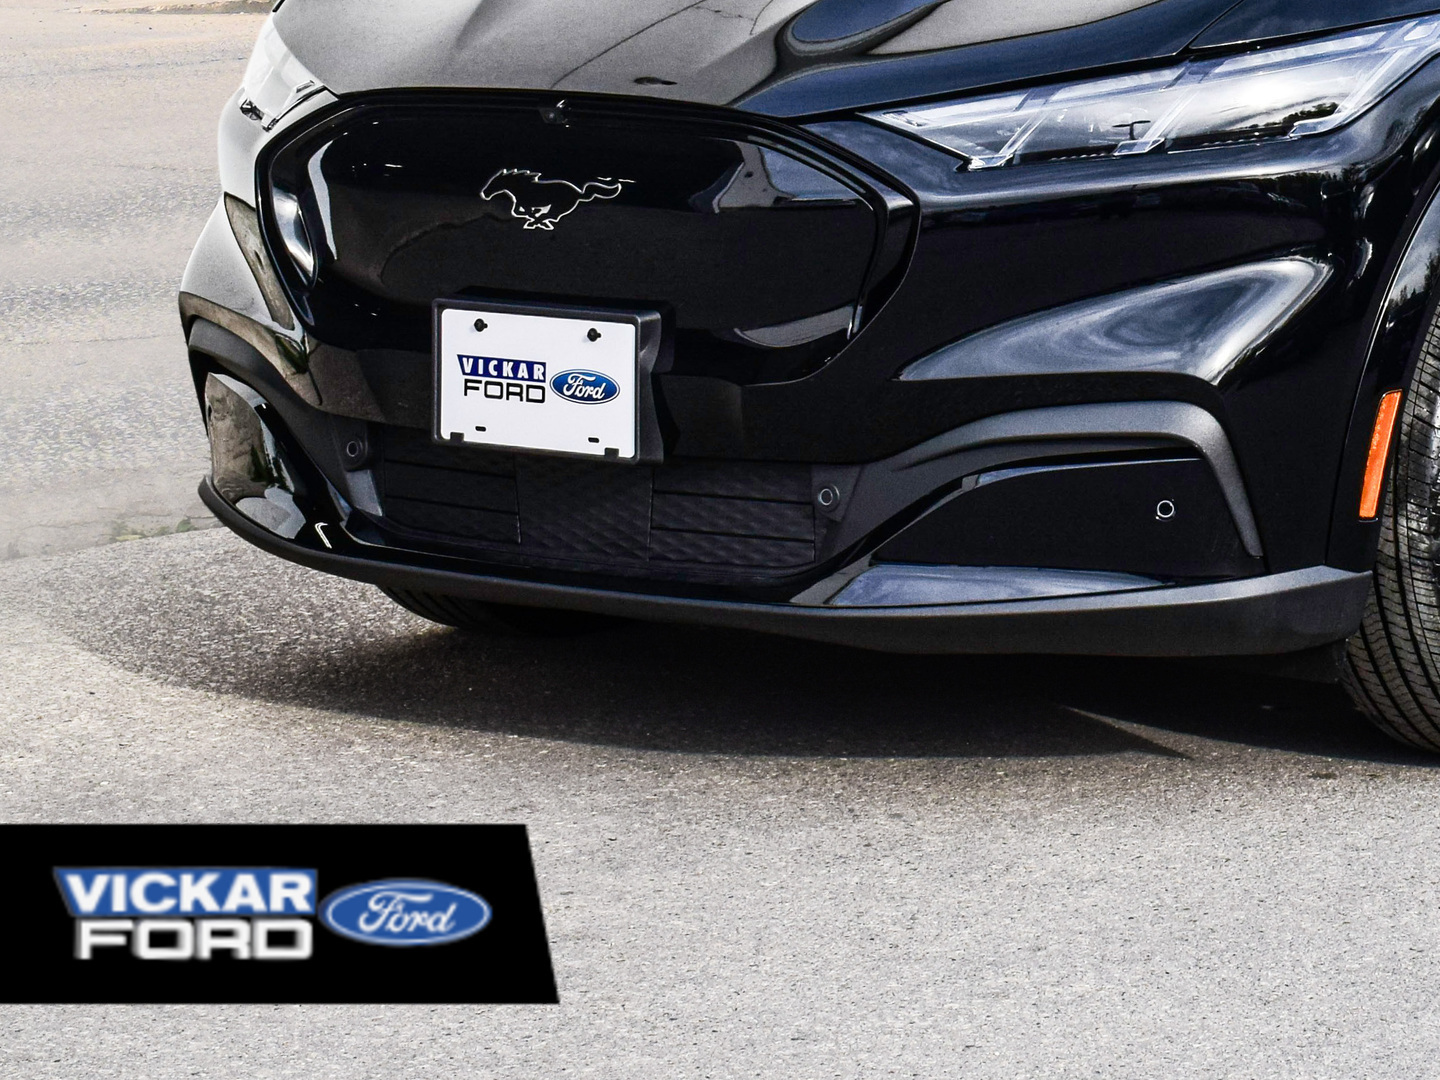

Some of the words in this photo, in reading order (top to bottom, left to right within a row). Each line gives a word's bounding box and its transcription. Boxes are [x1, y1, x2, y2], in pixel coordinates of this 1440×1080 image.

[461, 356, 546, 381] VICKAR
[463, 379, 546, 404] FORD
[562, 373, 607, 400] Ford
